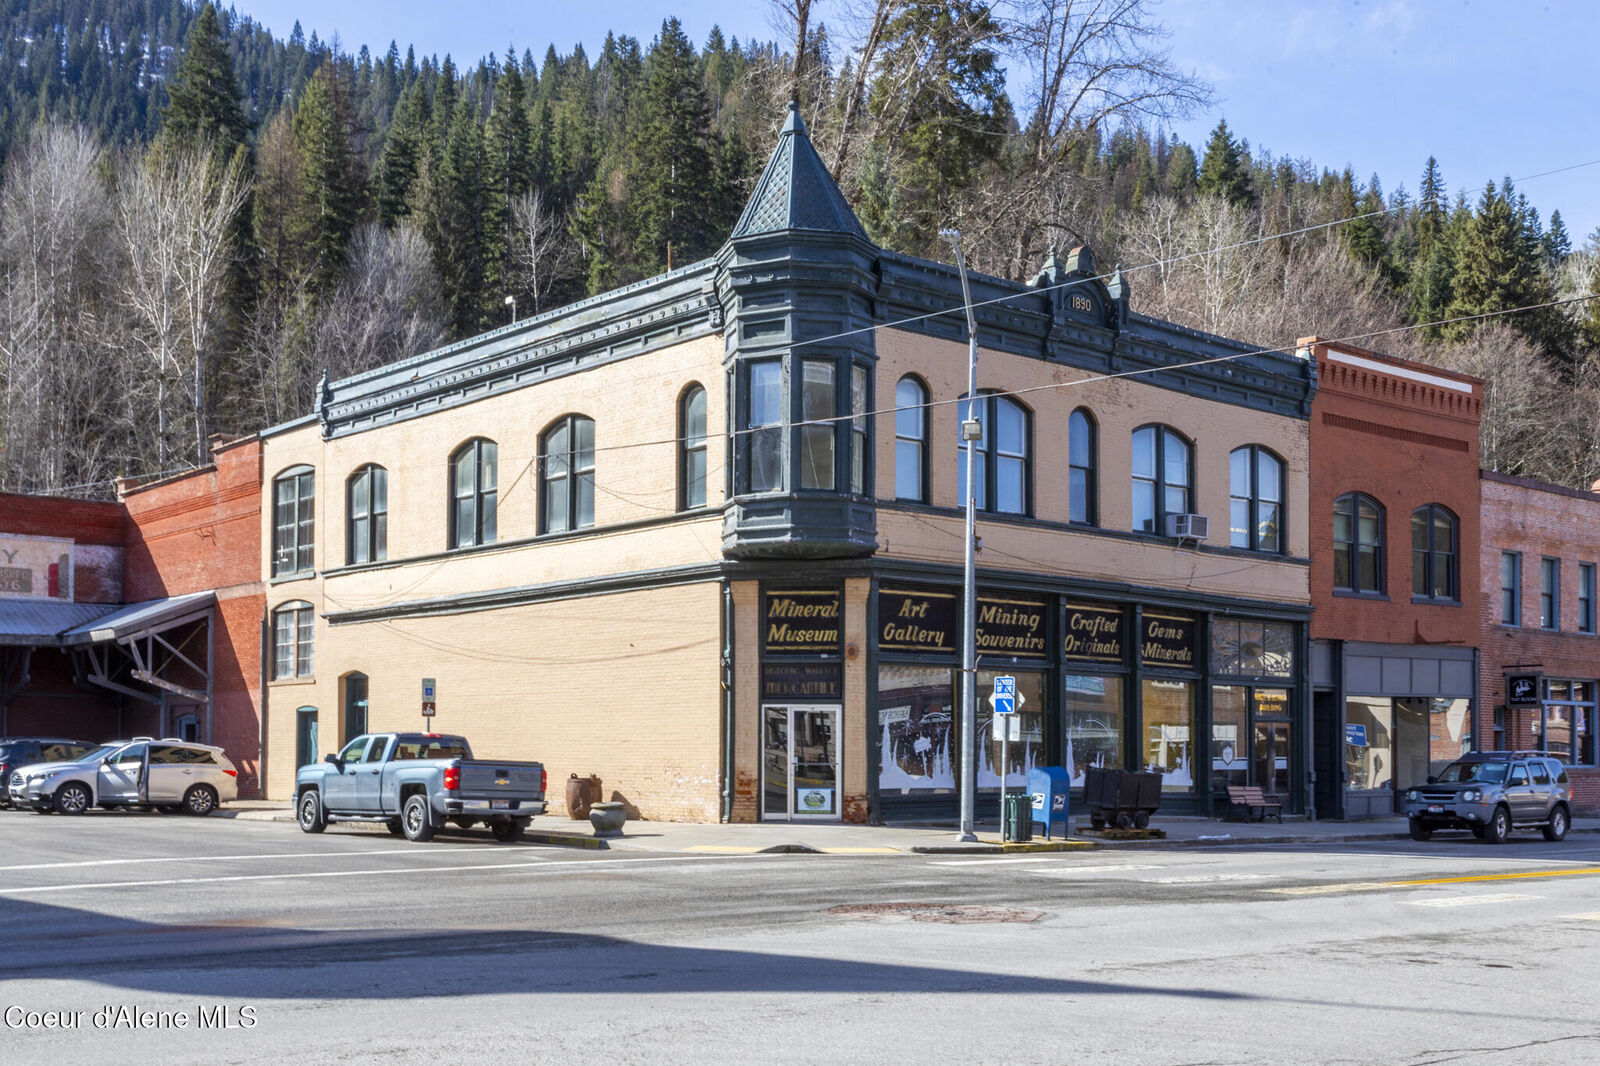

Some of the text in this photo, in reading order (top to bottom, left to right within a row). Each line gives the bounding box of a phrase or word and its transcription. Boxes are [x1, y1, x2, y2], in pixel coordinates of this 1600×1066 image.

[1072, 296, 1091, 311] 1890
[768, 599, 839, 617] Mineral
[898, 599, 930, 618] Art
[978, 605, 1040, 631] Mining
[768, 623, 838, 642] Museum
[883, 622, 944, 647] Gallery
[1070, 613, 1119, 637] Crafted
[1148, 621, 1184, 640] Gems
[976, 628, 1045, 650] Souvenirs
[1064, 634, 1120, 656] Originals
